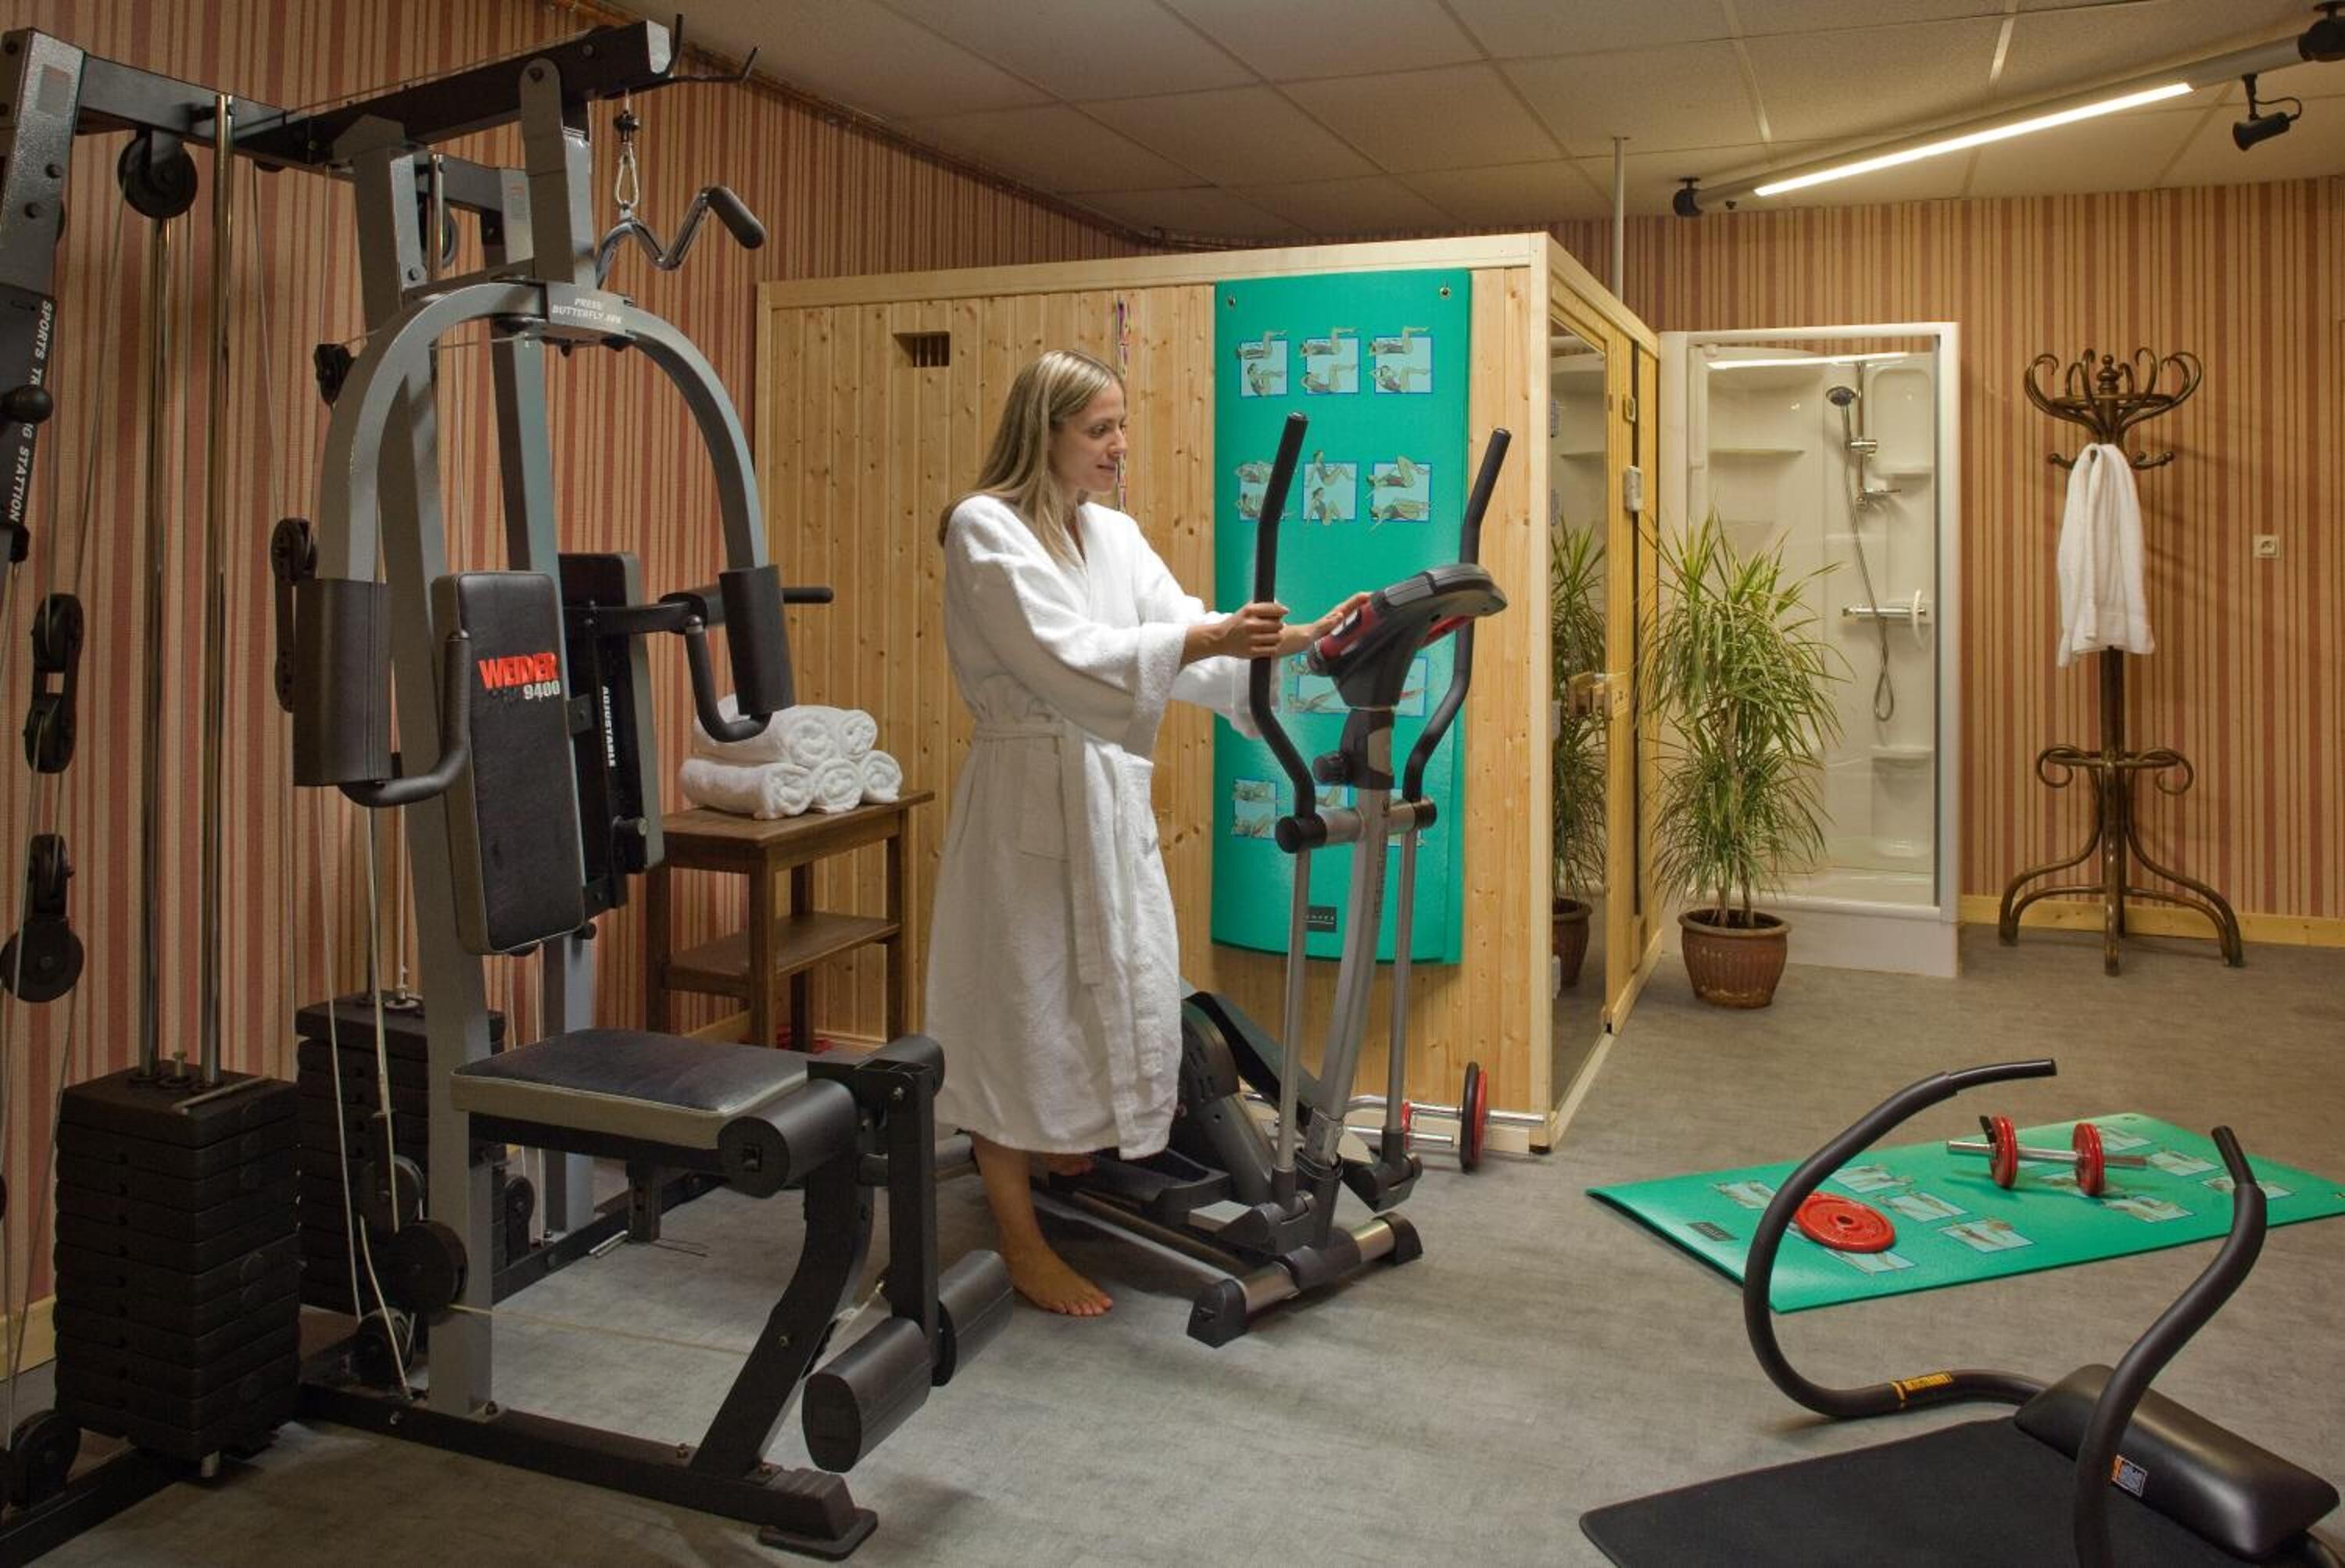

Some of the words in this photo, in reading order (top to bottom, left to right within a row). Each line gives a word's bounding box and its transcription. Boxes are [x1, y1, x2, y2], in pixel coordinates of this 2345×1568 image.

[34, 299, 52, 359] SPORTS
[552, 304, 603, 320] BUTTERFLY
[478, 652, 558, 689] WEIDER
[602, 685, 616, 767] ADJUSTABLE
